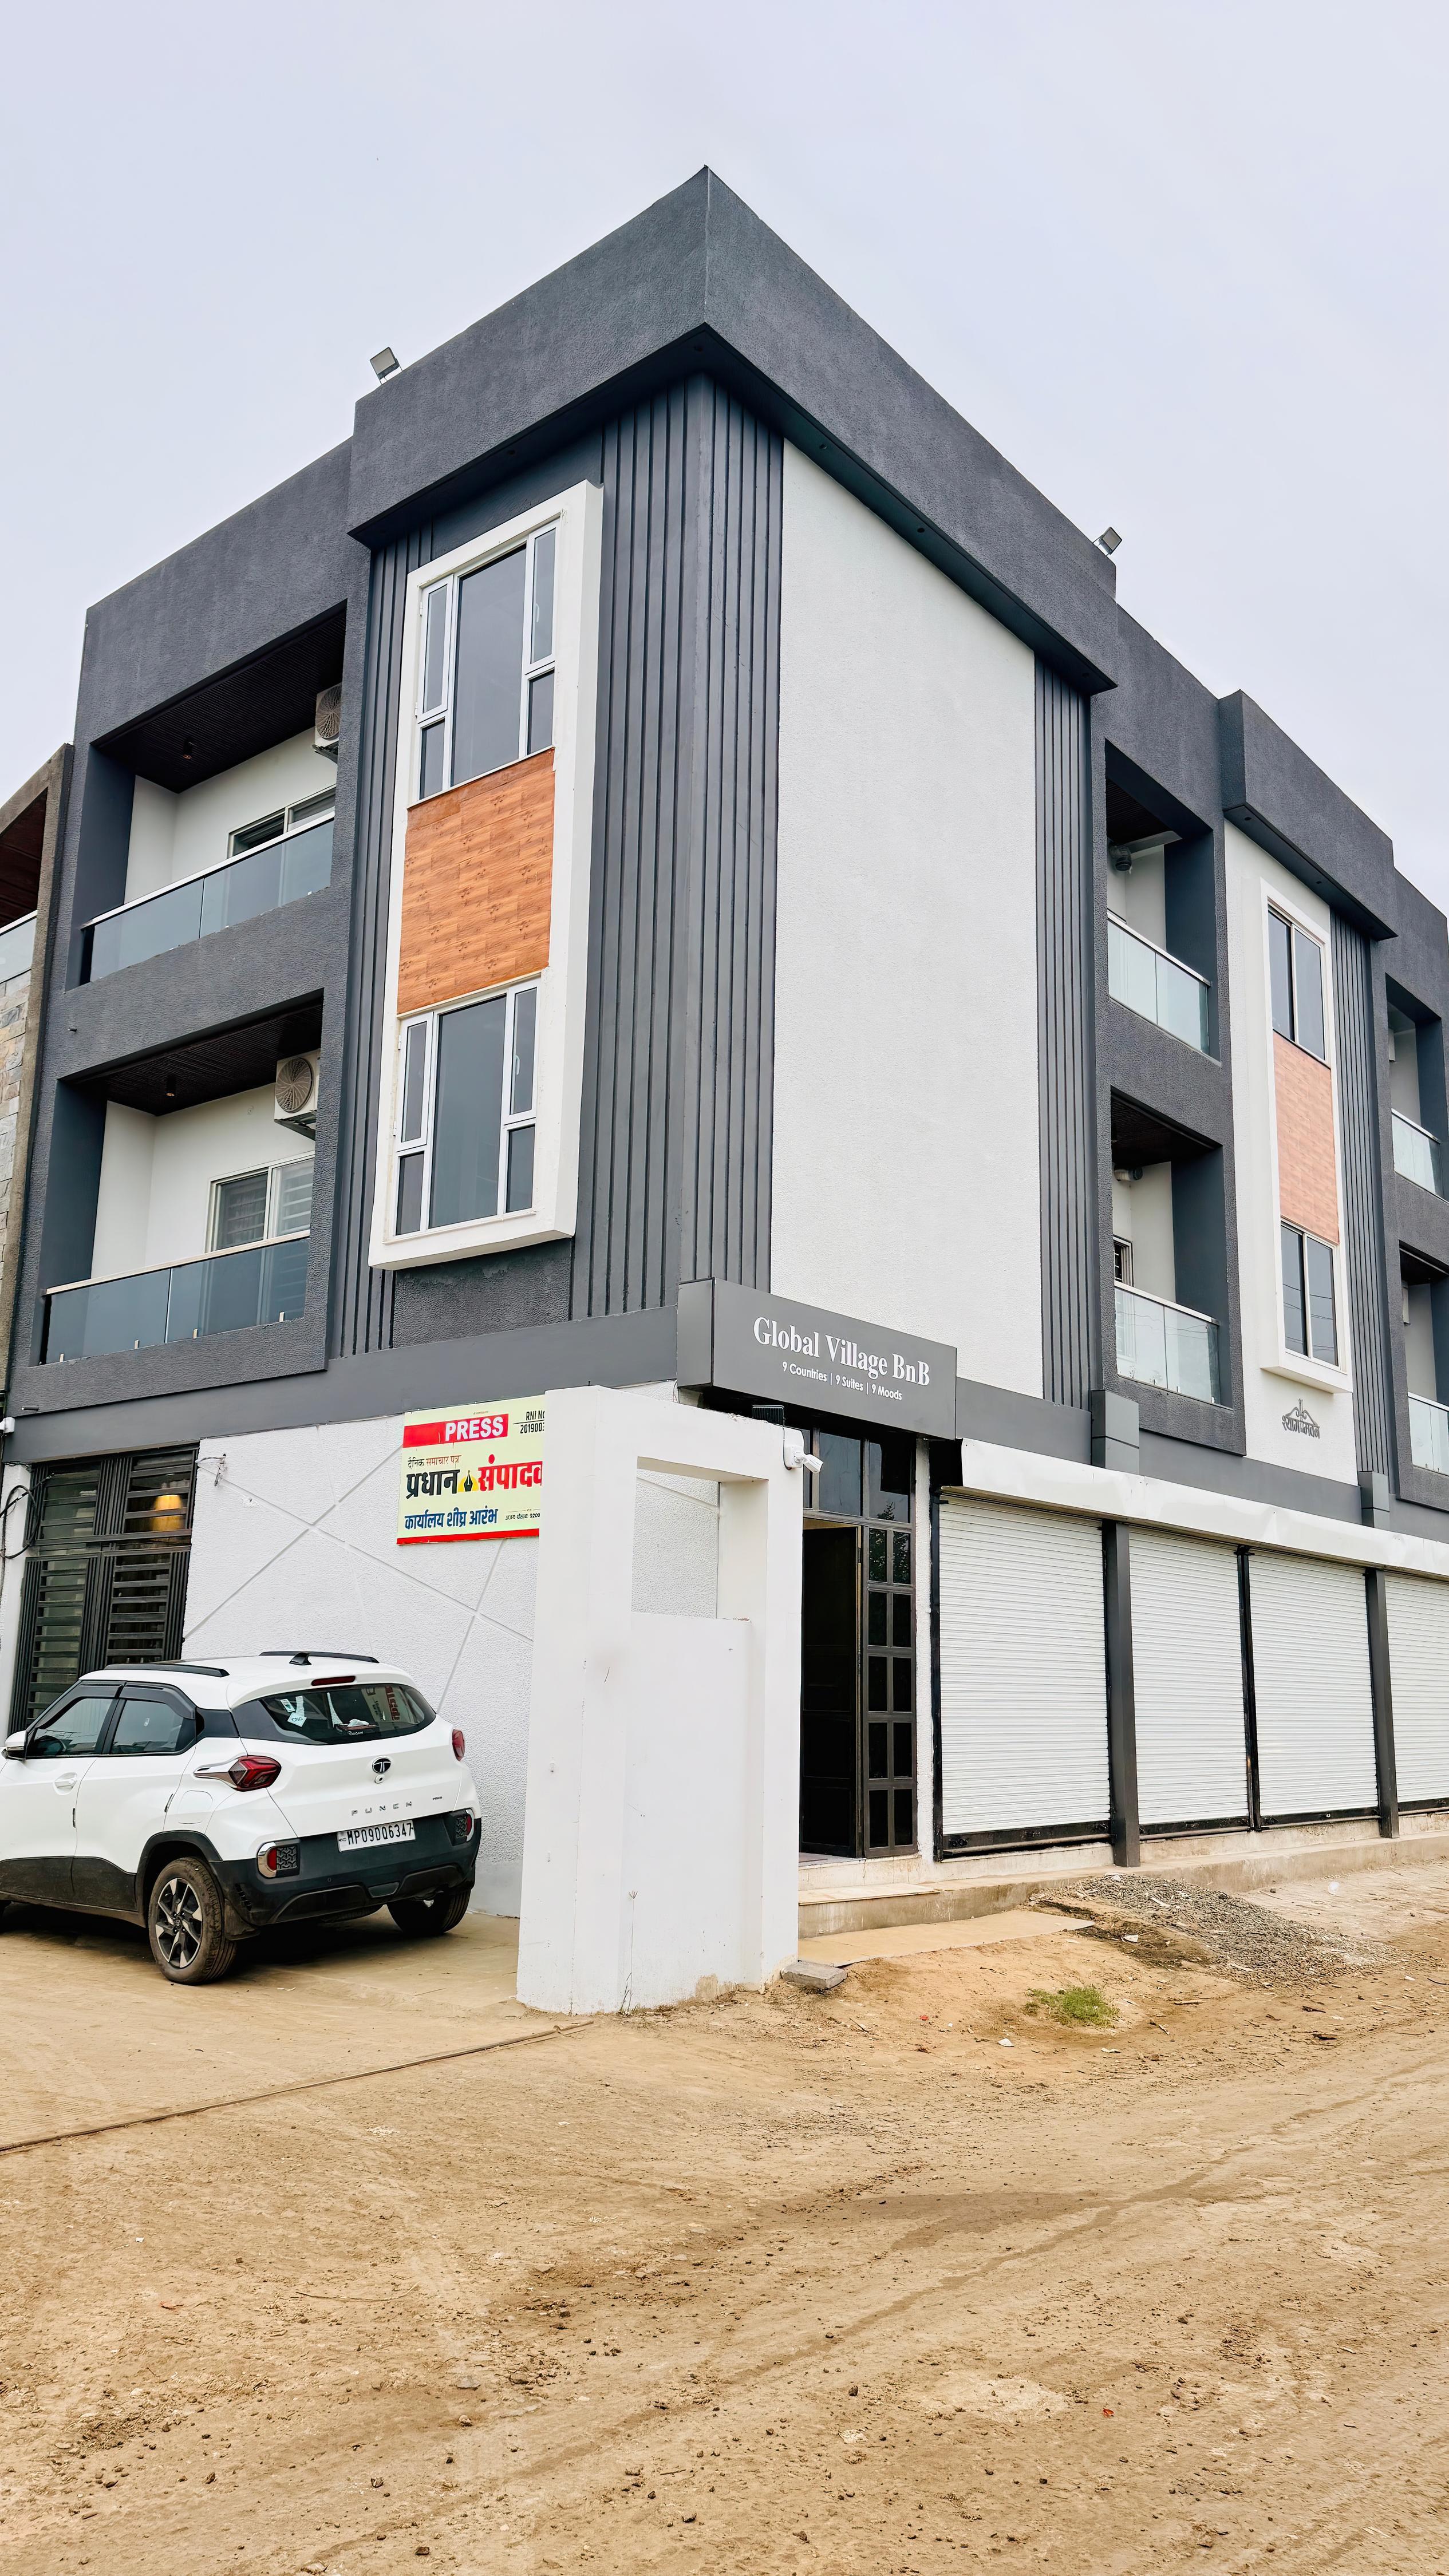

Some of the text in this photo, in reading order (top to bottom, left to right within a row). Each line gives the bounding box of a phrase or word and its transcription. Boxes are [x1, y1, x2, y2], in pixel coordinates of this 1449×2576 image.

[753, 1317, 930, 1386] Global Village BnB
[782, 1361, 788, 1372] 9
[789, 1363, 827, 1382] Countries
[835, 1374, 840, 1385] 9
[842, 1376, 863, 1392] Suites
[871, 1384, 876, 1394] 9
[878, 1386, 902, 1401] Moods
[445, 1416, 504, 1441] PRESS
[526, 1411, 536, 1421] RNI
[408, 1455, 461, 1468] दैनिक समाचार पत्र
[406, 1469, 460, 1499] प्रधान
[404, 1505, 499, 1530] कार्यालय शीघ्र आरंभ
[352, 1801, 412, 1816] PUNCH
